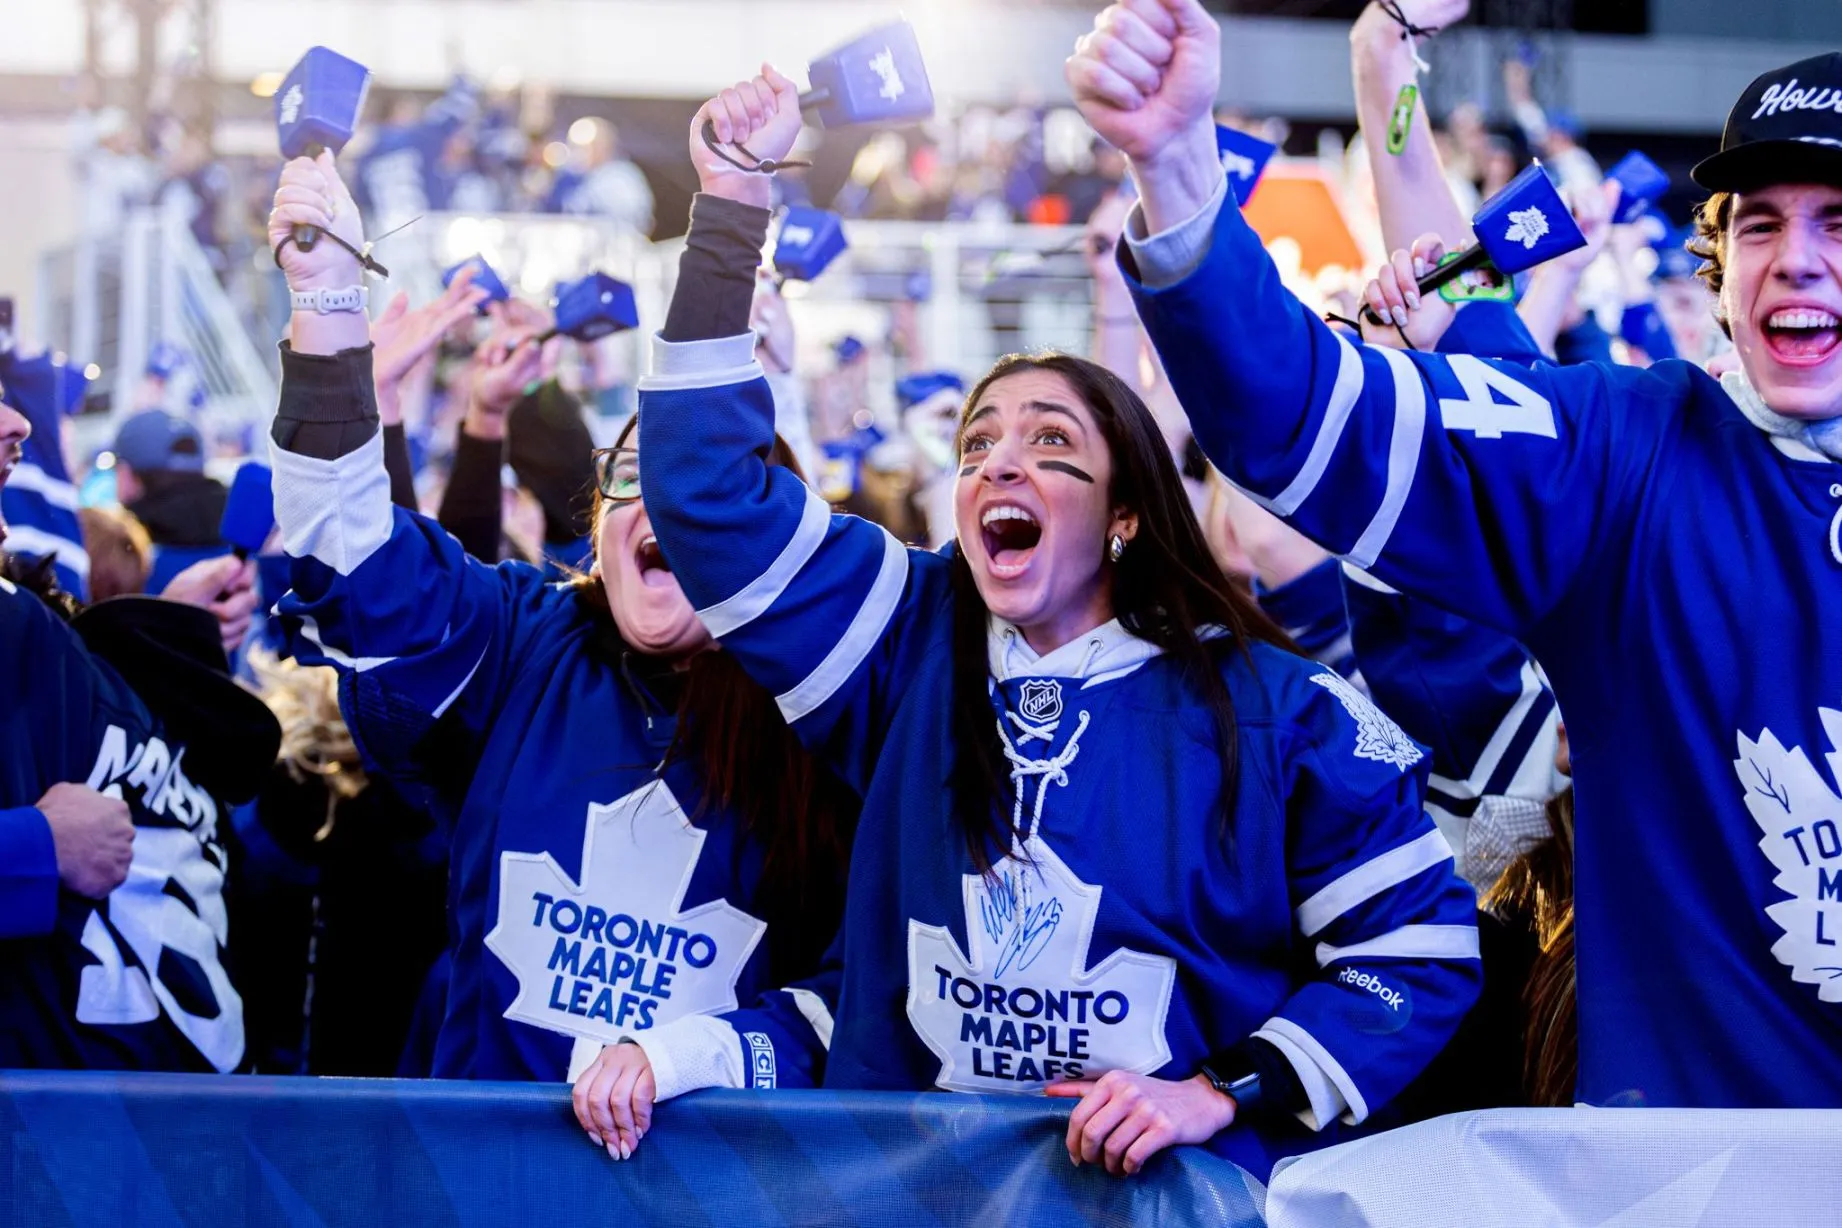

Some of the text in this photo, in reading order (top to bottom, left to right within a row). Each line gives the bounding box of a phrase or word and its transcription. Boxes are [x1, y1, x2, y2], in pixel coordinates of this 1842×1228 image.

[1439, 353, 1558, 439] 4
[1029, 690, 1054, 713] NHL
[533, 892, 717, 969] TORONTO
[1816, 911, 1836, 946] L
[547, 936, 677, 999] MAPLE
[935, 964, 1130, 1025] TORONTO
[548, 975, 659, 1031] LEAFS
[960, 1013, 1090, 1060] MAPLE
[972, 1048, 1085, 1082] LEAFS
